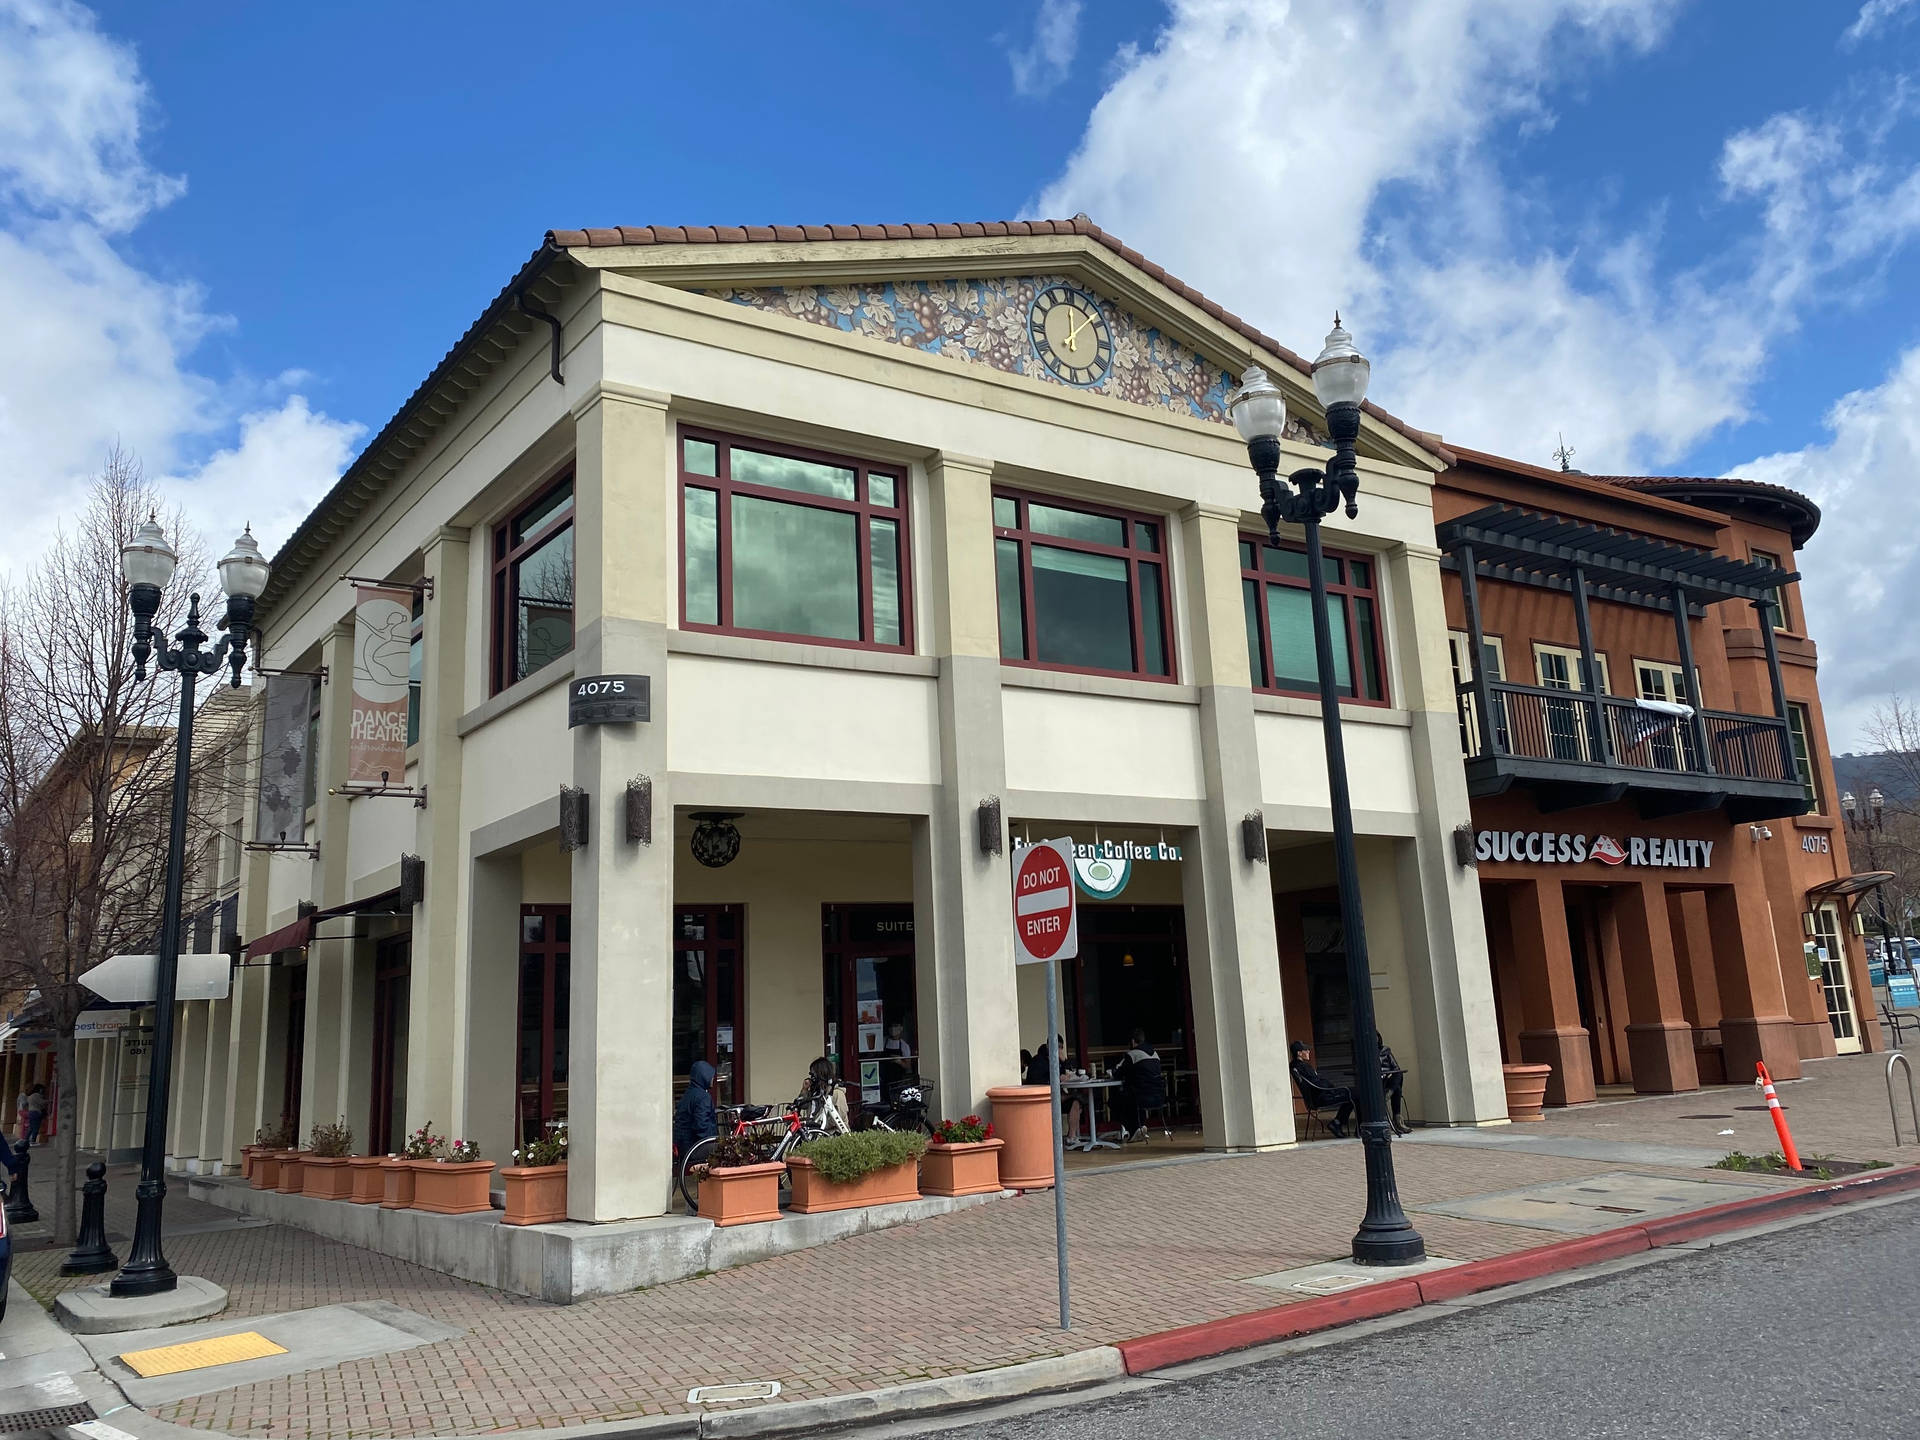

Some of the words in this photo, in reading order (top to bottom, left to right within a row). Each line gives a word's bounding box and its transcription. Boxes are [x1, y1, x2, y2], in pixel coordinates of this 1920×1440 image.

[577, 680, 625, 696] 4075
[352, 709, 407, 728] DANCE
[350, 721, 408, 743] THEATRE
[1103, 840, 1152, 860] Coffee
[1158, 842, 1183, 861] Co.
[1476, 830, 1586, 863] SUCCESS
[1630, 836, 1714, 868] REALTY
[1802, 834, 1828, 853] 4075
[1023, 874, 1037, 889] DO
[1039, 867, 1061, 886] NOT
[876, 921, 914, 931] SUITE
[1026, 915, 1061, 936] ENTER
